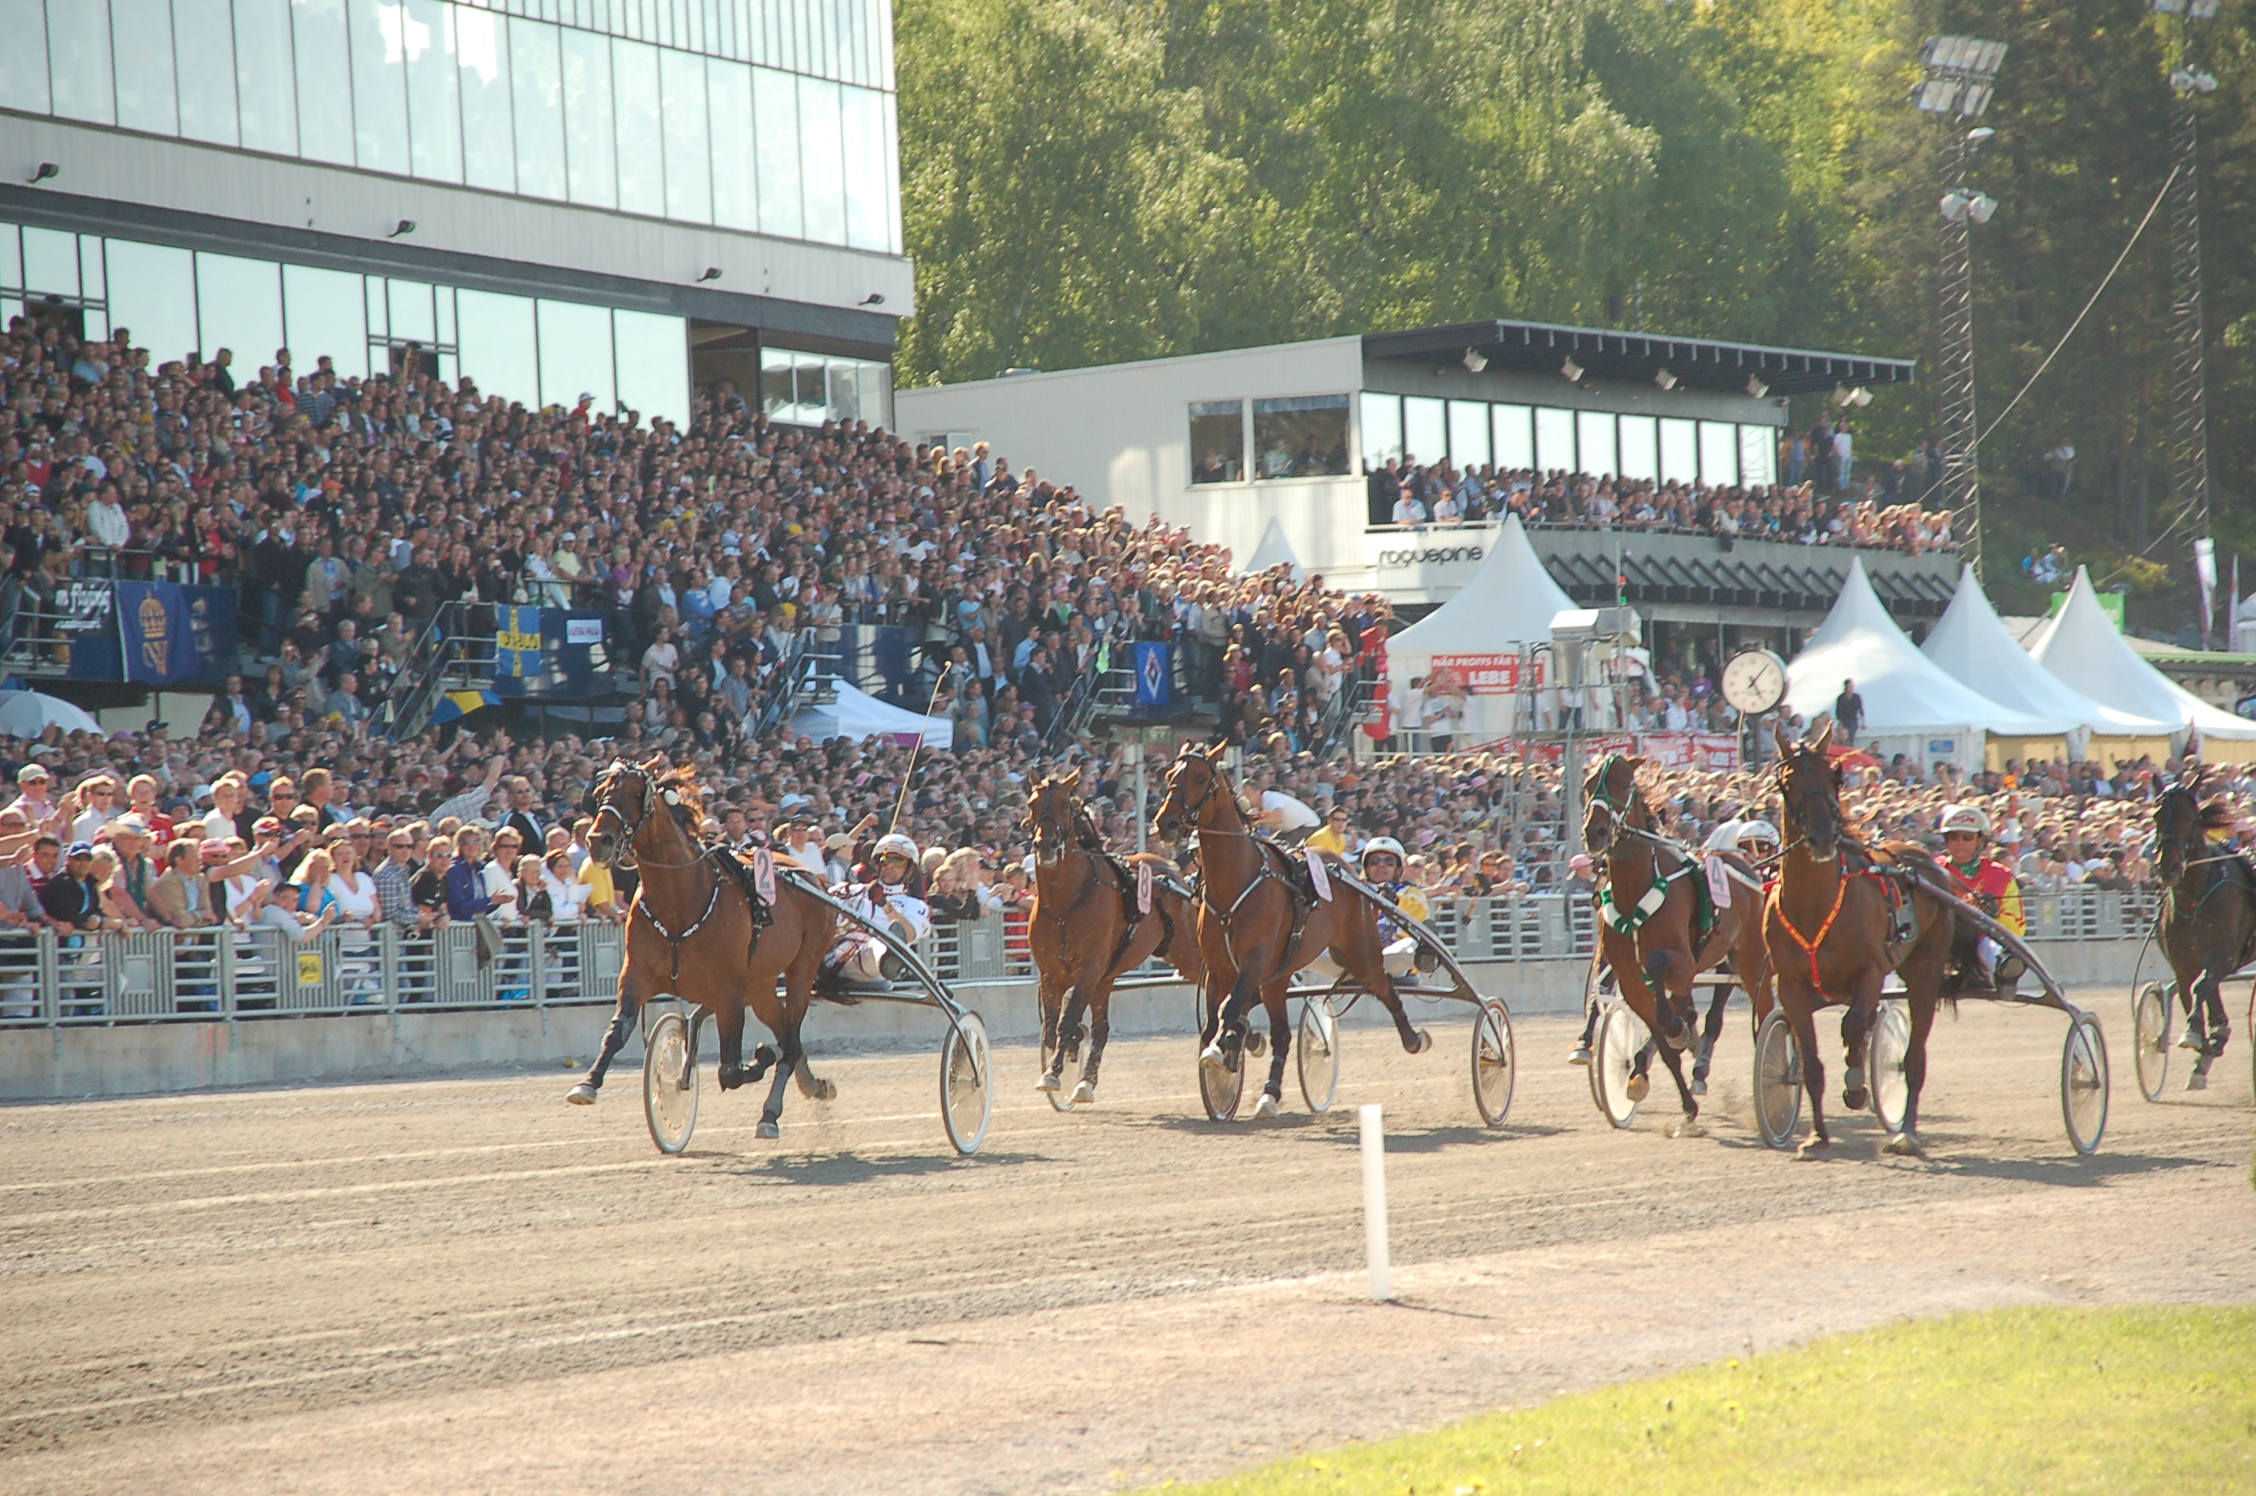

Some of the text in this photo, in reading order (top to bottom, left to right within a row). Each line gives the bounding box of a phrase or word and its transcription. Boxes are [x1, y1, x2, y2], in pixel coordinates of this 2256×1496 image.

[1379, 546, 1483, 568] roquepine
[1468, 670, 1511, 685] LEBE
[757, 851, 771, 889] 2
[1140, 866, 1149, 898] 8
[1712, 859, 1725, 891] 4
